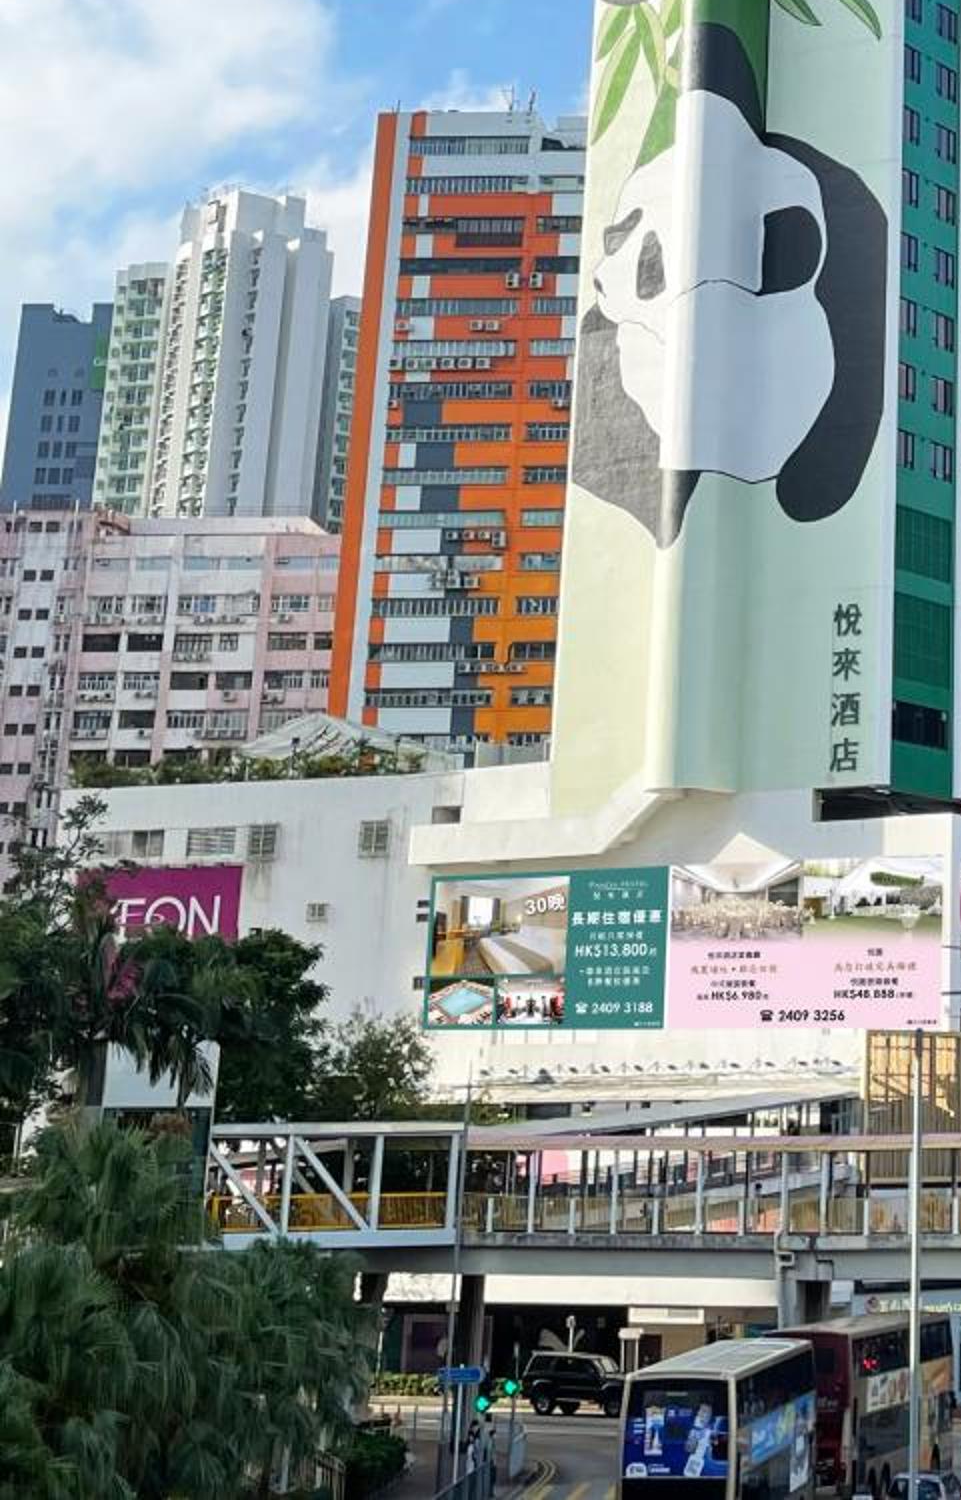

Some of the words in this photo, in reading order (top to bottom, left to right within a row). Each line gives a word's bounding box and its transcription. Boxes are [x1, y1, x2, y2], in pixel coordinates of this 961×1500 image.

[830, 603, 862, 772] 悅來酒店
[592, 1002, 620, 1014] 2409
[623, 1001, 653, 1013] 3188
[779, 1009, 809, 1022] 2409
[813, 1009, 845, 1021] 3256
